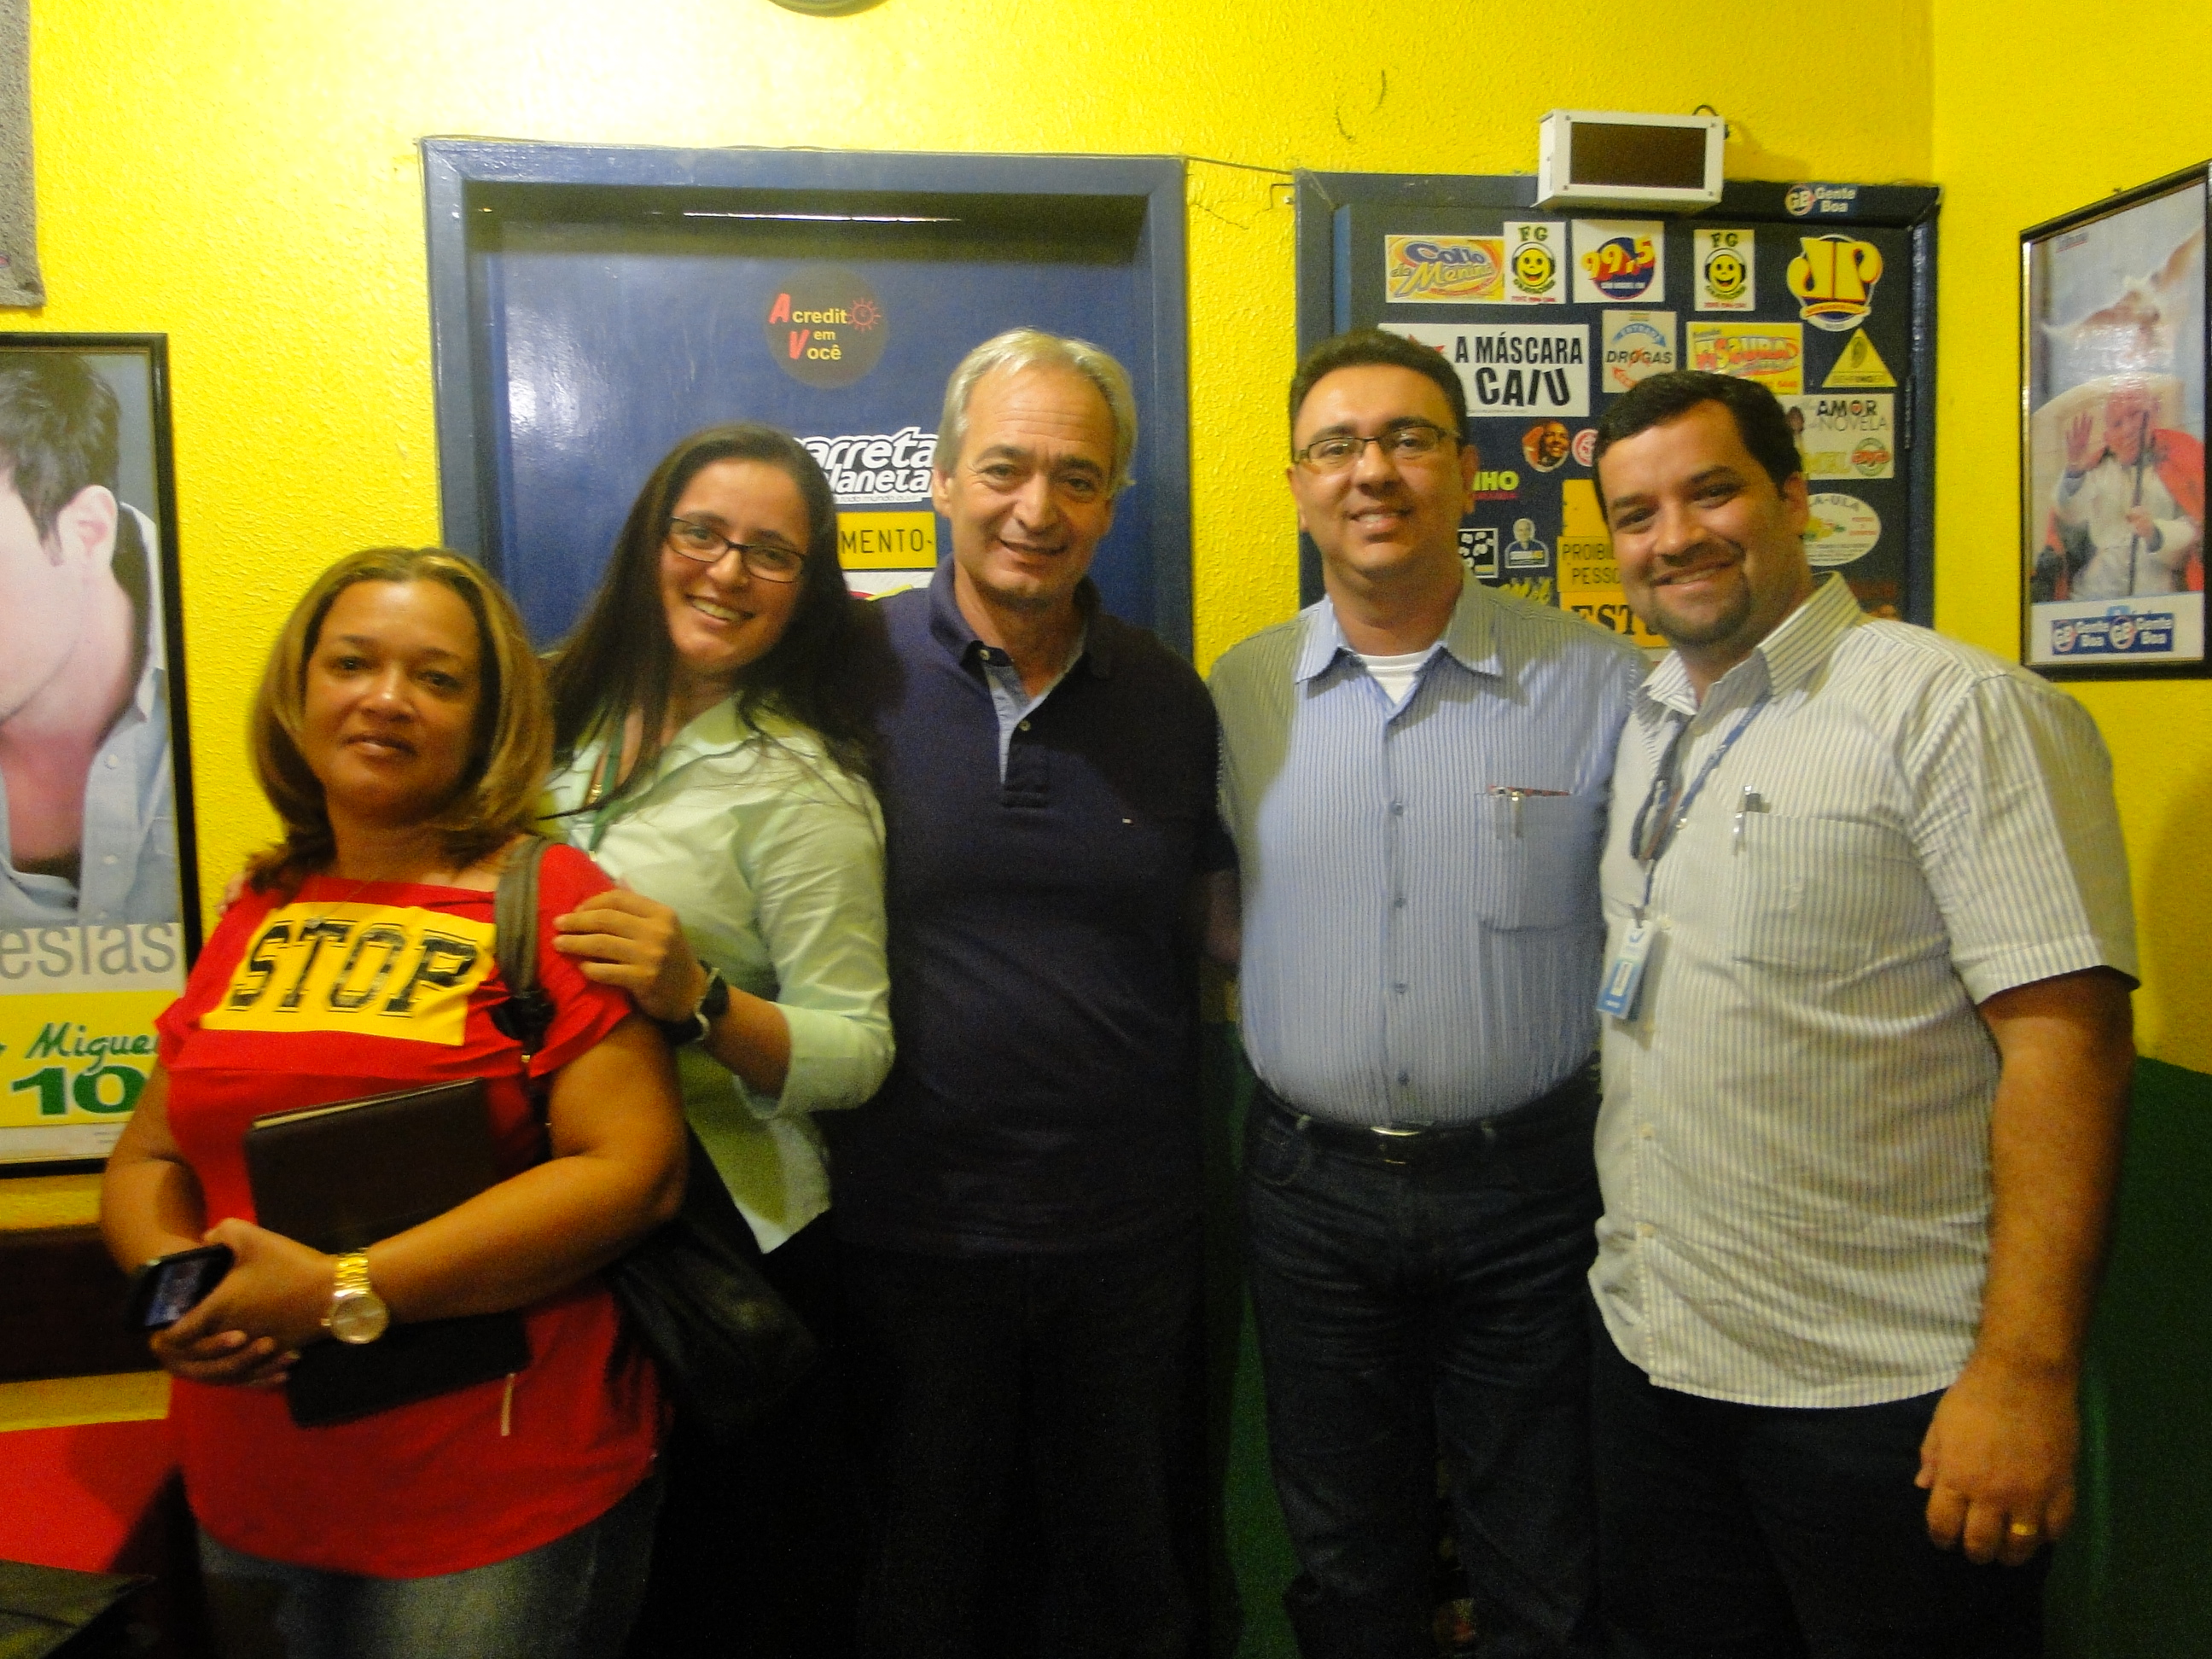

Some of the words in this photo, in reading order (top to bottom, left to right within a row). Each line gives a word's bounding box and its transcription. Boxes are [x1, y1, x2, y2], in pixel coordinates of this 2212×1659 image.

[1814, 187, 1856, 200] Gente
[1820, 200, 1848, 212] Boa
[789, 329, 842, 360] Você
[812, 330, 836, 341] em
[1455, 335, 1469, 363] A
[1475, 331, 1583, 364] MÁSCARA
[1605, 350, 1673, 364] DROGAS
[1476, 367, 1571, 407] CAIU
[1817, 399, 1877, 417] AMOR
[805, 432, 938, 469] arreta
[824, 463, 933, 493] laneta
[225, 920, 480, 1018] STOP
